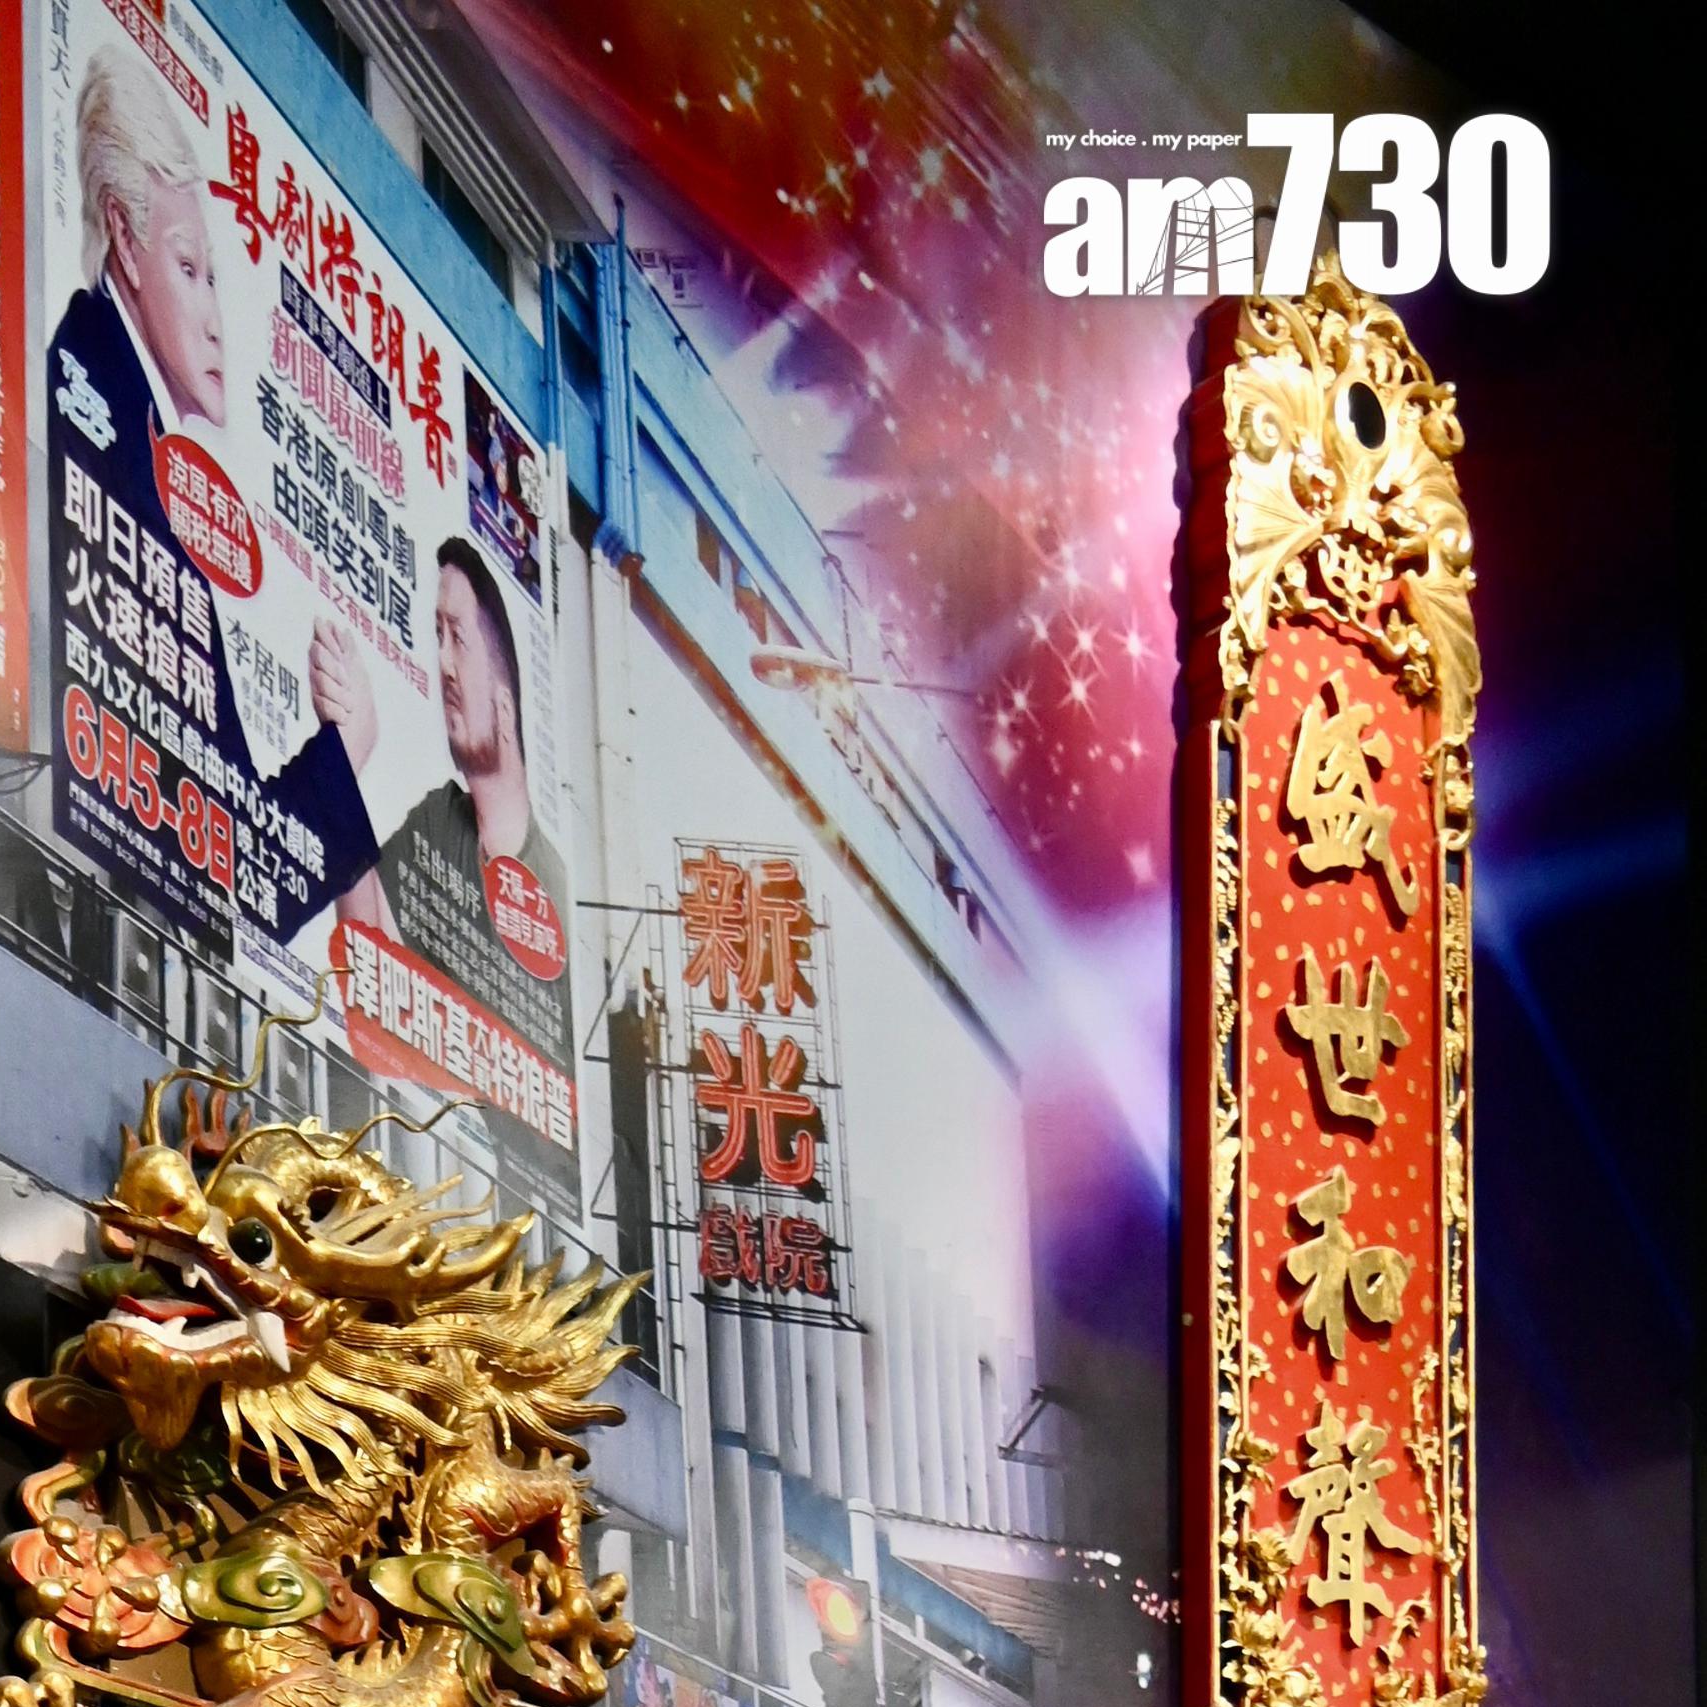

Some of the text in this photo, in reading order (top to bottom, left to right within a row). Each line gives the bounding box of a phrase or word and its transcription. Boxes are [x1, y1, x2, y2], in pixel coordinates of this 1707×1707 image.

[208, 102, 453, 490] 粵劇特朗普
[257, 374, 416, 590] 香港原創粵劇
[271, 306, 405, 499] 新聞最前線
[64, 455, 213, 653] 即日預售
[65, 547, 217, 732] 火速搶飛
[273, 463, 413, 650] 由頭笑到尾
[226, 615, 300, 720] 李居明
[63, 684, 235, 893] 6月5-8日
[236, 819, 309, 904] 晚上7:30
[237, 859, 278, 928] 公演
[680, 846, 815, 1185] 新光
[699, 1204, 828, 1295] 戲院
[1286, 669, 1423, 1648] 盛世和聲
